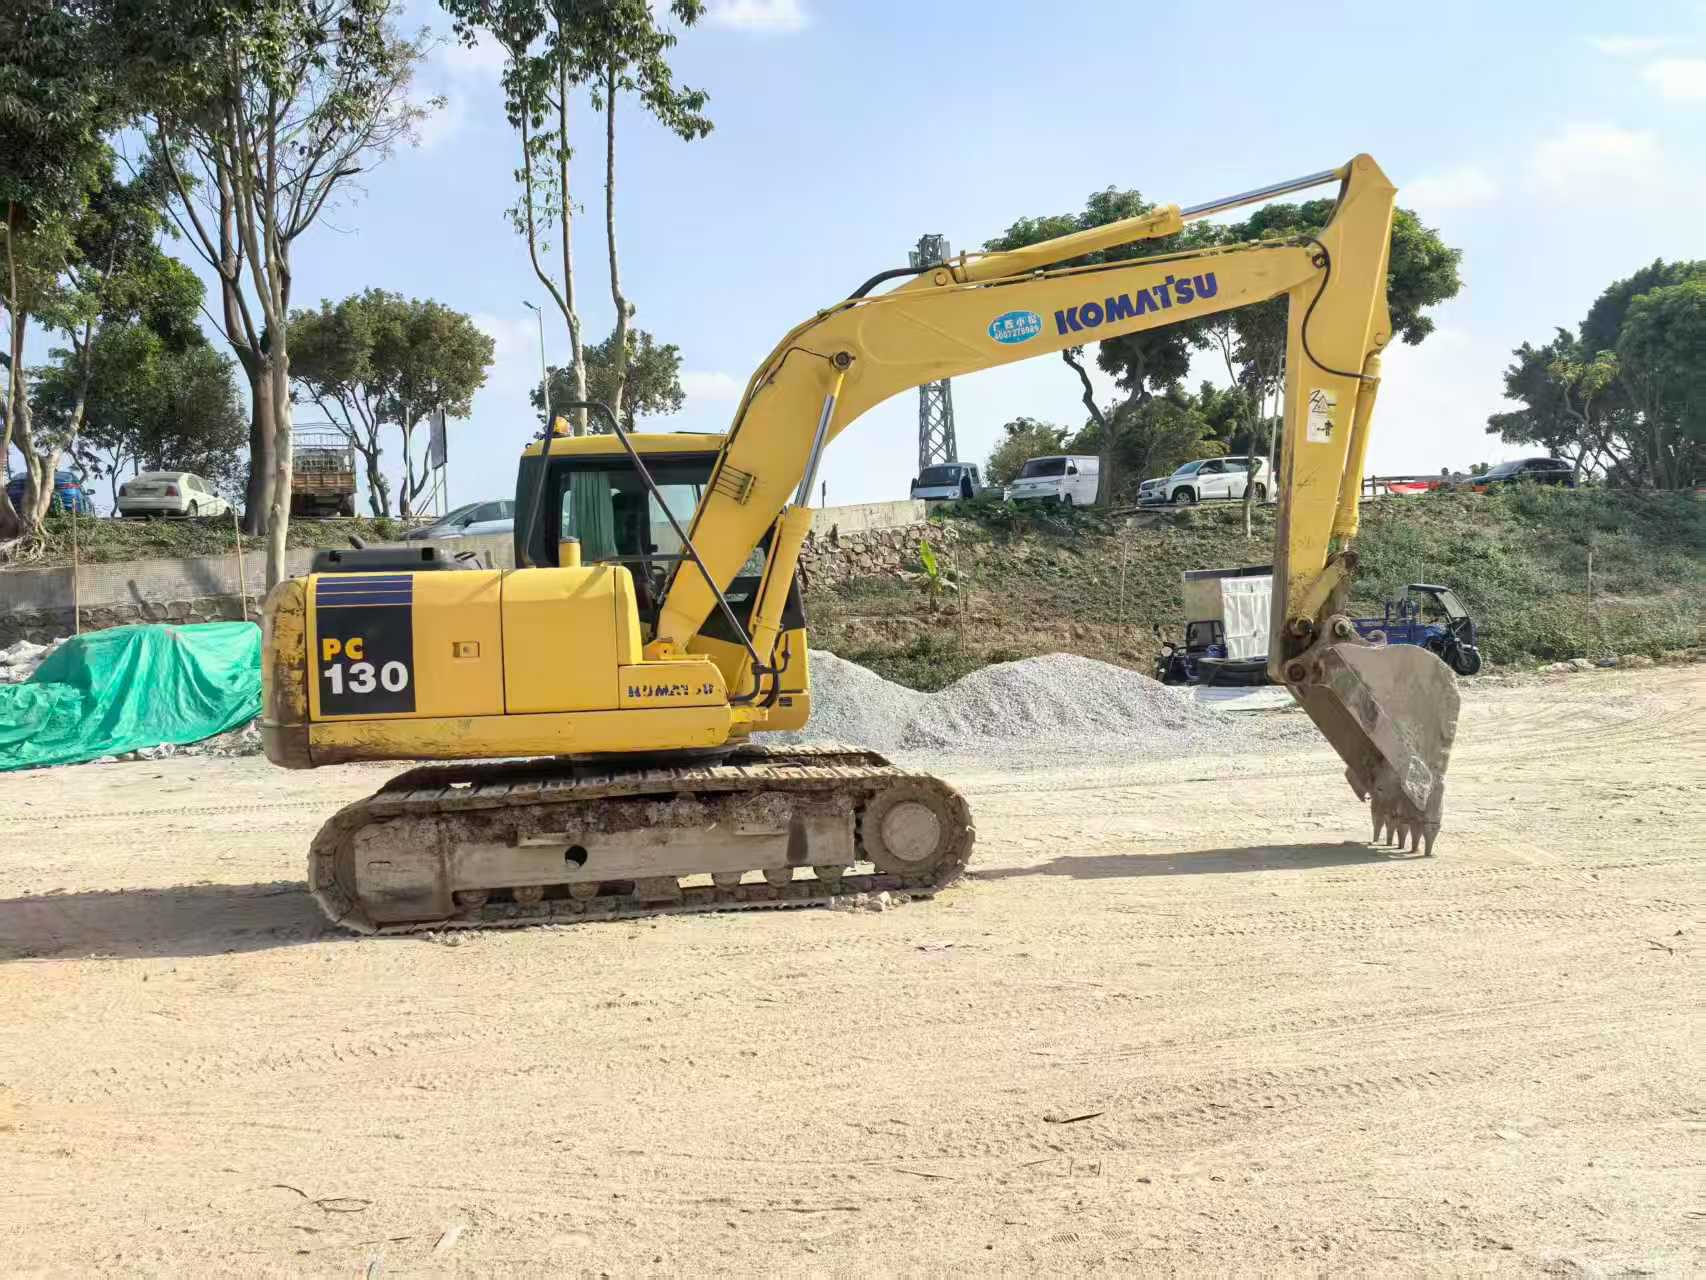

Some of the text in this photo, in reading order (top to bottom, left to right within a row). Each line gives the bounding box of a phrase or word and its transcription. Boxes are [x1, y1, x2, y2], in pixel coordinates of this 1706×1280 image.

[1055, 272, 1217, 335] KOMATSU
[322, 637, 364, 661] PC
[324, 660, 409, 694] 130
